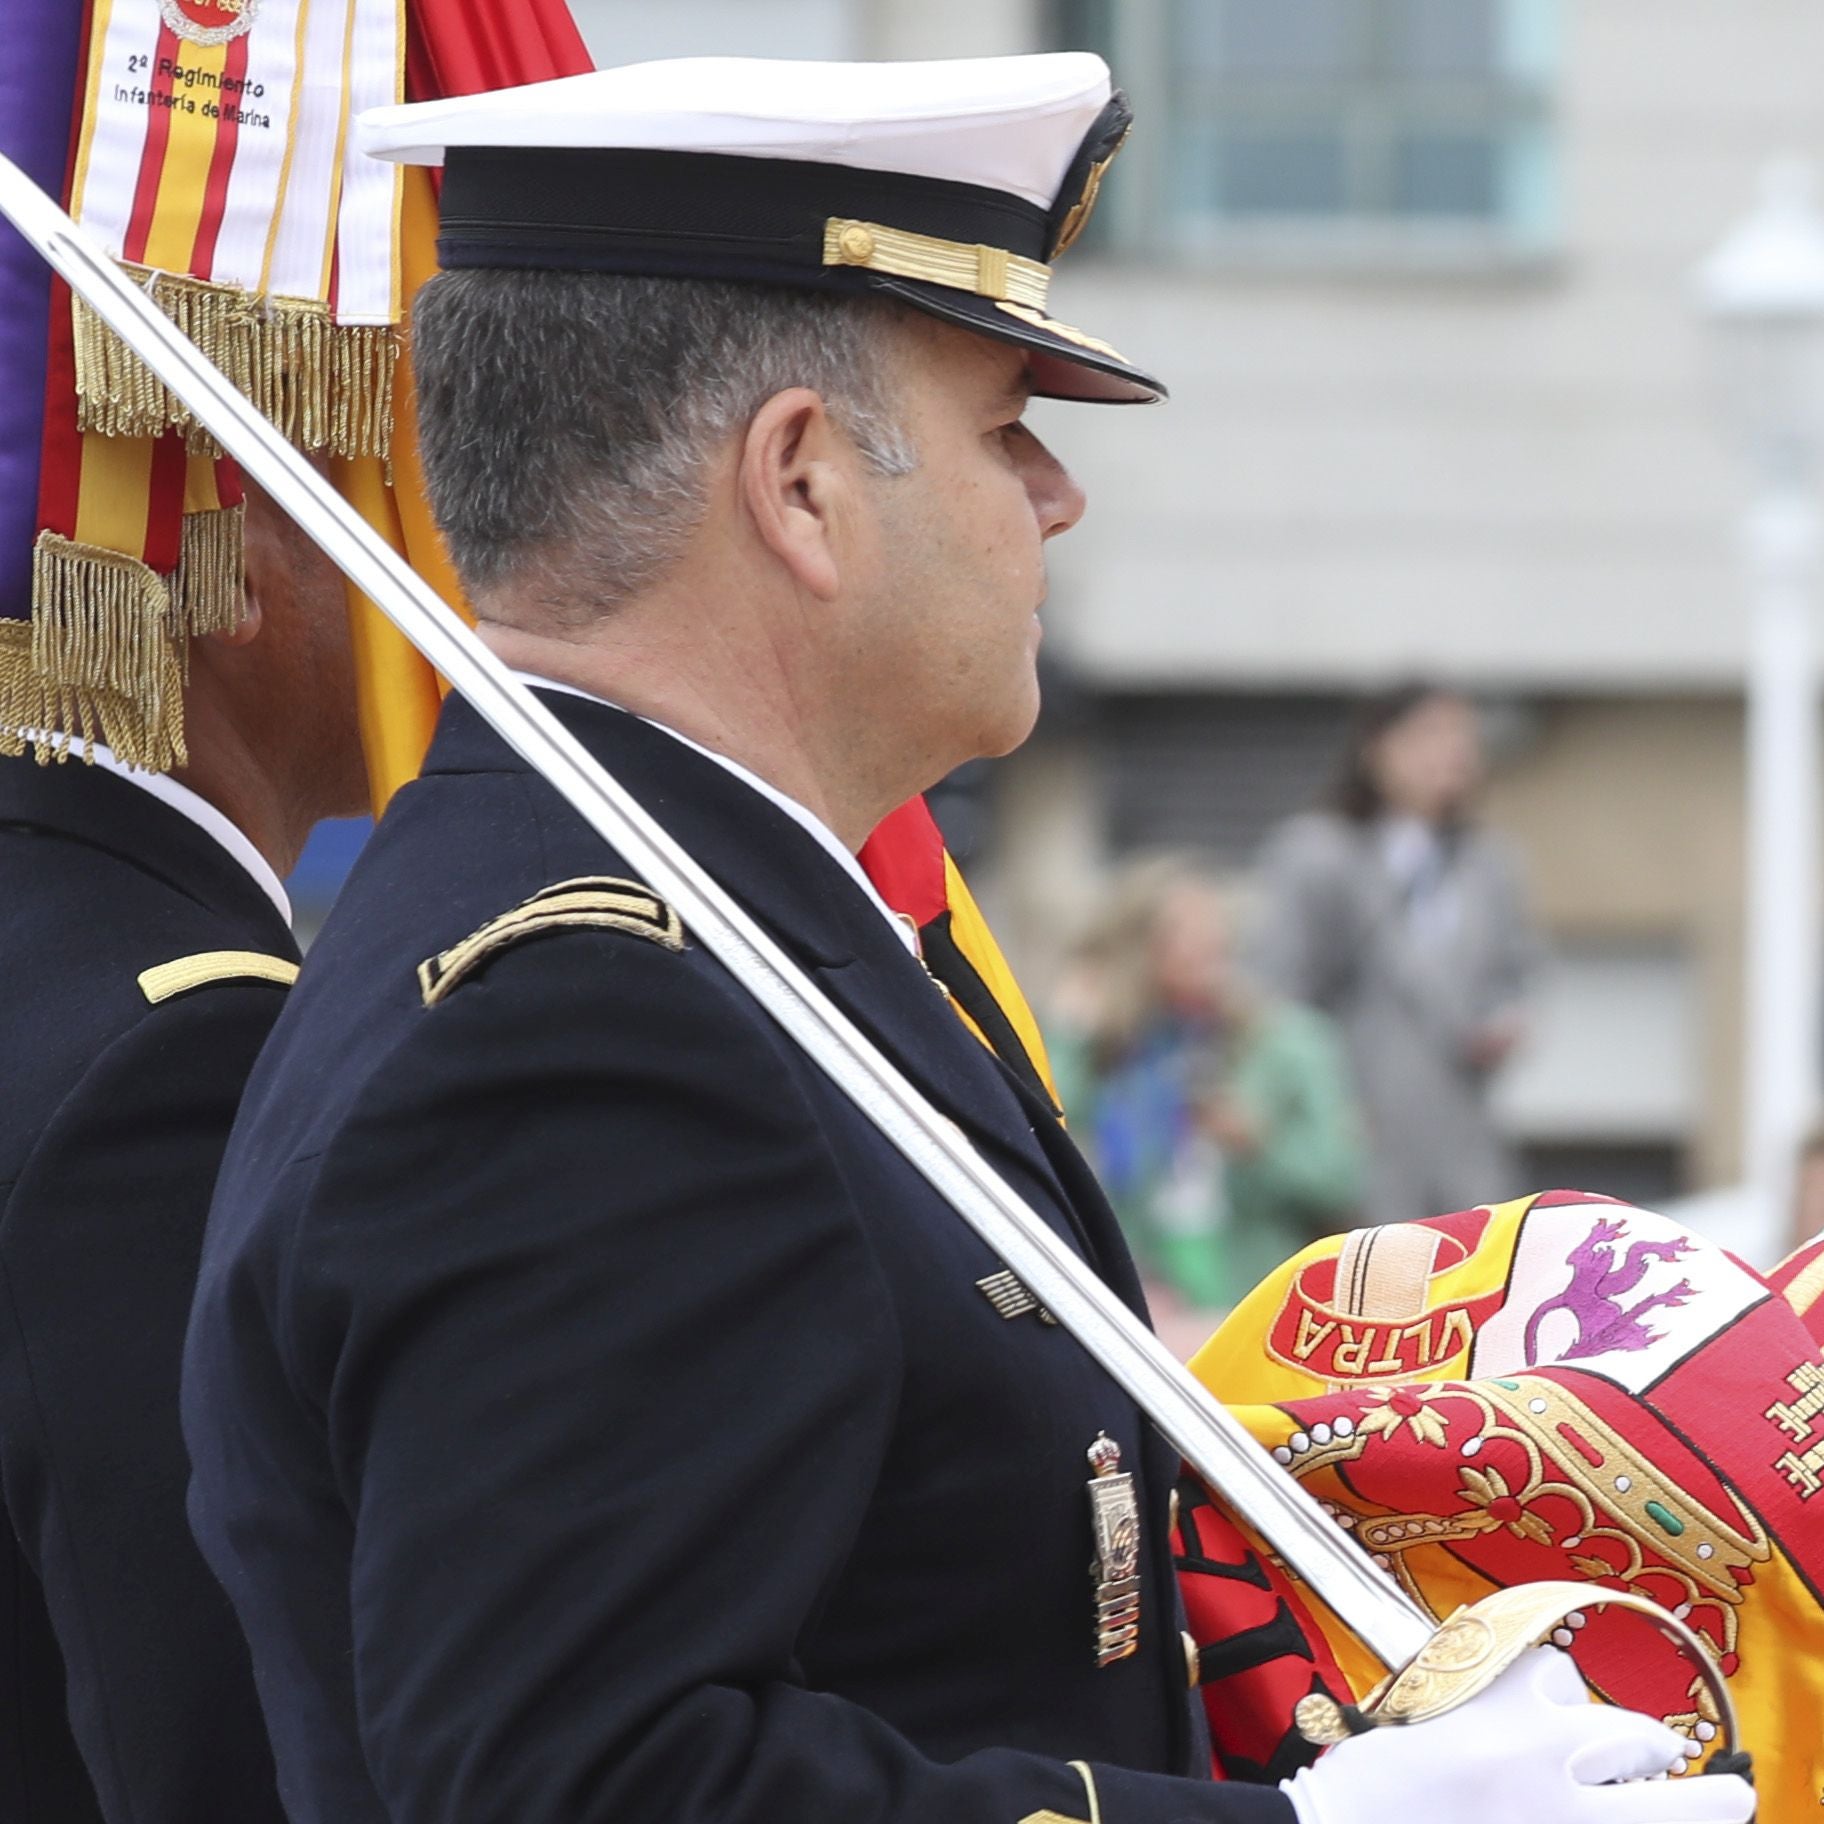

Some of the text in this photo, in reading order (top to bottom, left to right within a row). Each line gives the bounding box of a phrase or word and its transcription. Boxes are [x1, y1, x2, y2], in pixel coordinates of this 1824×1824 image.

[158, 57, 265, 98] Regimiento
[201, 100, 220, 118] de
[223, 103, 270, 129] Marina
[1290, 1307, 1474, 1376] VLTRA
